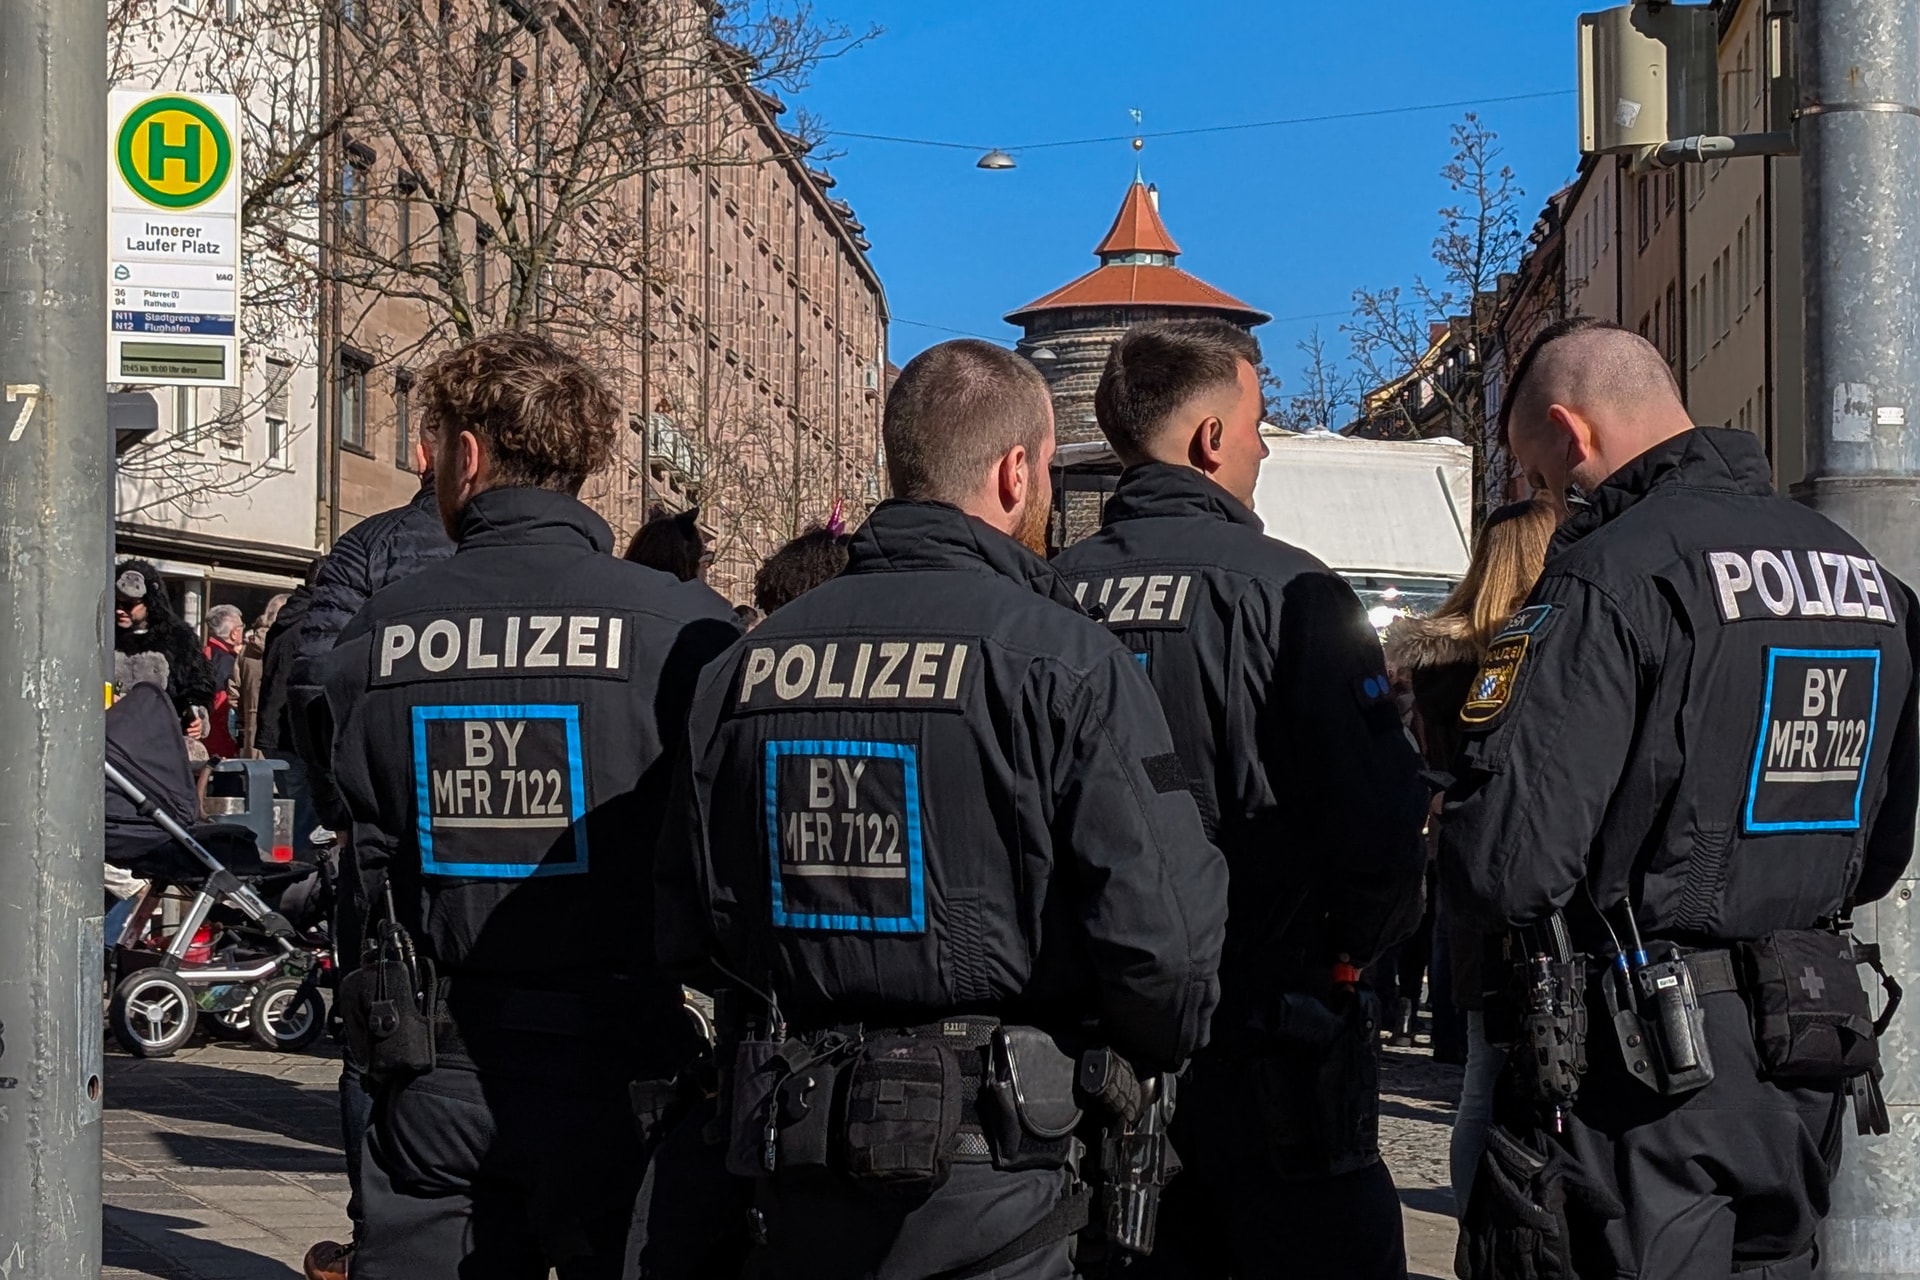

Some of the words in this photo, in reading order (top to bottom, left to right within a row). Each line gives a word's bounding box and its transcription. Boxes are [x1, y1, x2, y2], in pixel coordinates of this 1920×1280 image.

[148, 121, 201, 183] H
[126, 237, 177, 252] Laufer
[182, 240, 220, 254] Platz
[145, 222, 202, 238] Innerer
[115, 312, 133, 320] N11
[144, 313, 201, 323] Stadtgrenze
[115, 322, 134, 331] N12
[144, 323, 191, 333] Flughafen
[143, 300, 176, 308] Rathaus
[1709, 550, 1897, 623] POLIZEI
[379, 616, 623, 677] POLIZEI
[740, 642, 968, 703] POLIZEI
[1803, 668, 1848, 717] BY
[464, 720, 527, 767] BY
[1767, 720, 1819, 768] MFR
[1823, 719, 1866, 768] 7122
[433, 769, 492, 815] MFR
[501, 769, 563, 815] 7122
[809, 758, 867, 809] BY
[782, 811, 834, 863] MFR
[841, 812, 902, 864] 7122
